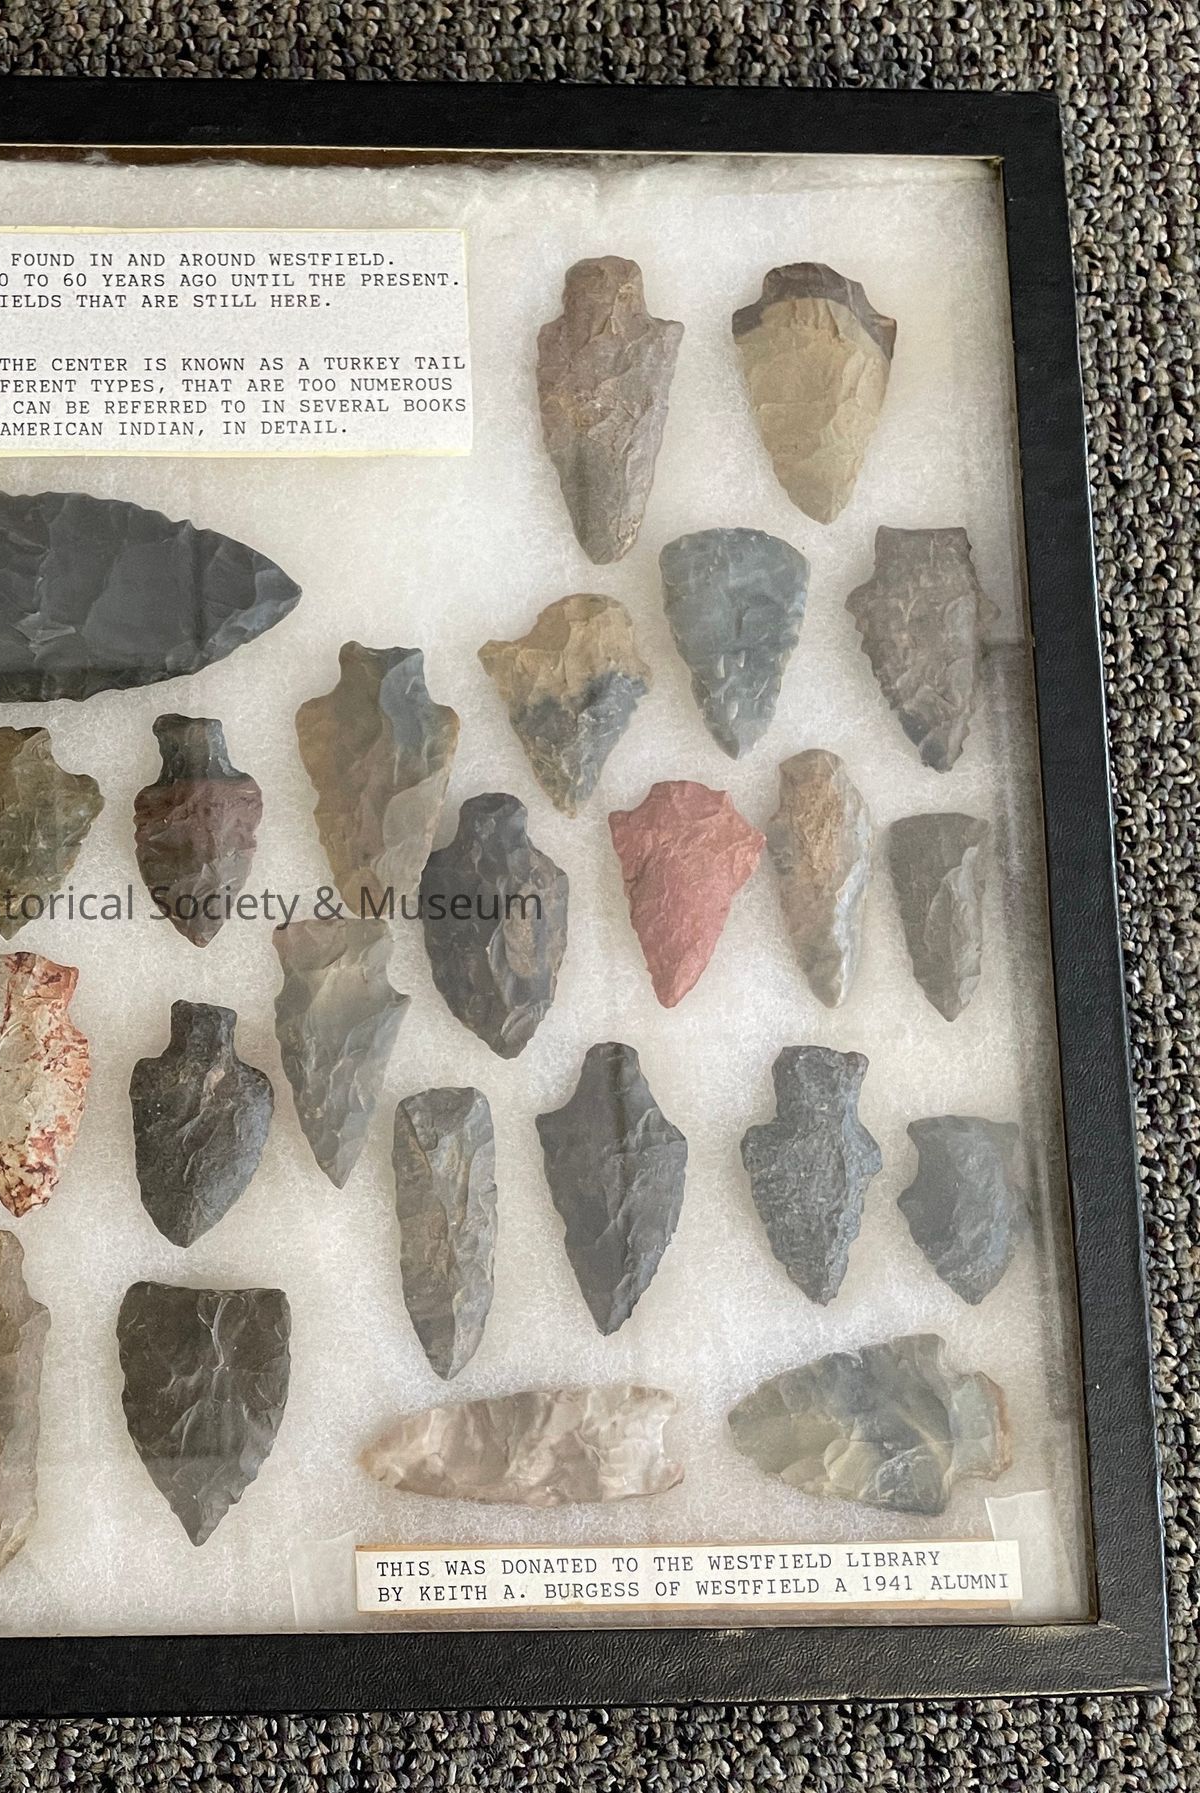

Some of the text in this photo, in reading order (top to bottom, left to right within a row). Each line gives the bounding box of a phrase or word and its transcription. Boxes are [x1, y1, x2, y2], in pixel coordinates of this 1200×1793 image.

[10, 252, 75, 267] FOUND
[89, 253, 113, 267] IN
[127, 253, 166, 267] AND
[178, 252, 256, 267] AROUND
[268, 252, 394, 267] WESTFIELD.
[23, 273, 49, 288] TO
[63, 272, 87, 288] 60
[101, 273, 166, 288] YEARS
[179, 273, 217, 288] AGO
[230, 273, 295, 288] UNTIL
[308, 273, 346, 287] THE
[360, 272, 459, 287] PRESENT.
[75, 294, 127, 308] THAT
[140, 294, 179, 309] ARE
[192, 293, 257, 308] STILL
[269, 293, 331, 308] HERE.
[51, 357, 128, 372] CENTER
[143, 357, 167, 372] IS
[180, 357, 245, 372] KNOWN
[259, 357, 284, 371] AS
[297, 357, 310, 371] A
[323, 356, 401, 371] TURKEY
[414, 355, 466, 370] TAIL
[90, 378, 165, 394] TYPES,
[181, 378, 233, 393] THAT
[246, 378, 285, 393] ARE
[298, 378, 337, 392] TOO
[349, 377, 453, 392] NUMEROUS
[12, 400, 52, 415] CAN
[65, 400, 90, 415] BE
[103, 400, 208, 415] REFERRED
[220, 399, 246, 414] TO
[260, 399, 286, 414] IN
[299, 398, 390, 413] SEVERAL
[402, 398, 466, 413] BOOKS
[0, 421, 104, 437] AMERICAN
[118, 421, 204, 436] INDIAN,
[222, 420, 247, 435] IN
[260, 419, 347, 435] DETAIL.
[376, 1550, 940, 1578] THIS WAS DONATED TO THE WESTFIELD LIBRARY
[377, 1573, 1009, 1603] BY KEITH A. BURGESS OF WESTFIELD A 1941 ALUMNI
